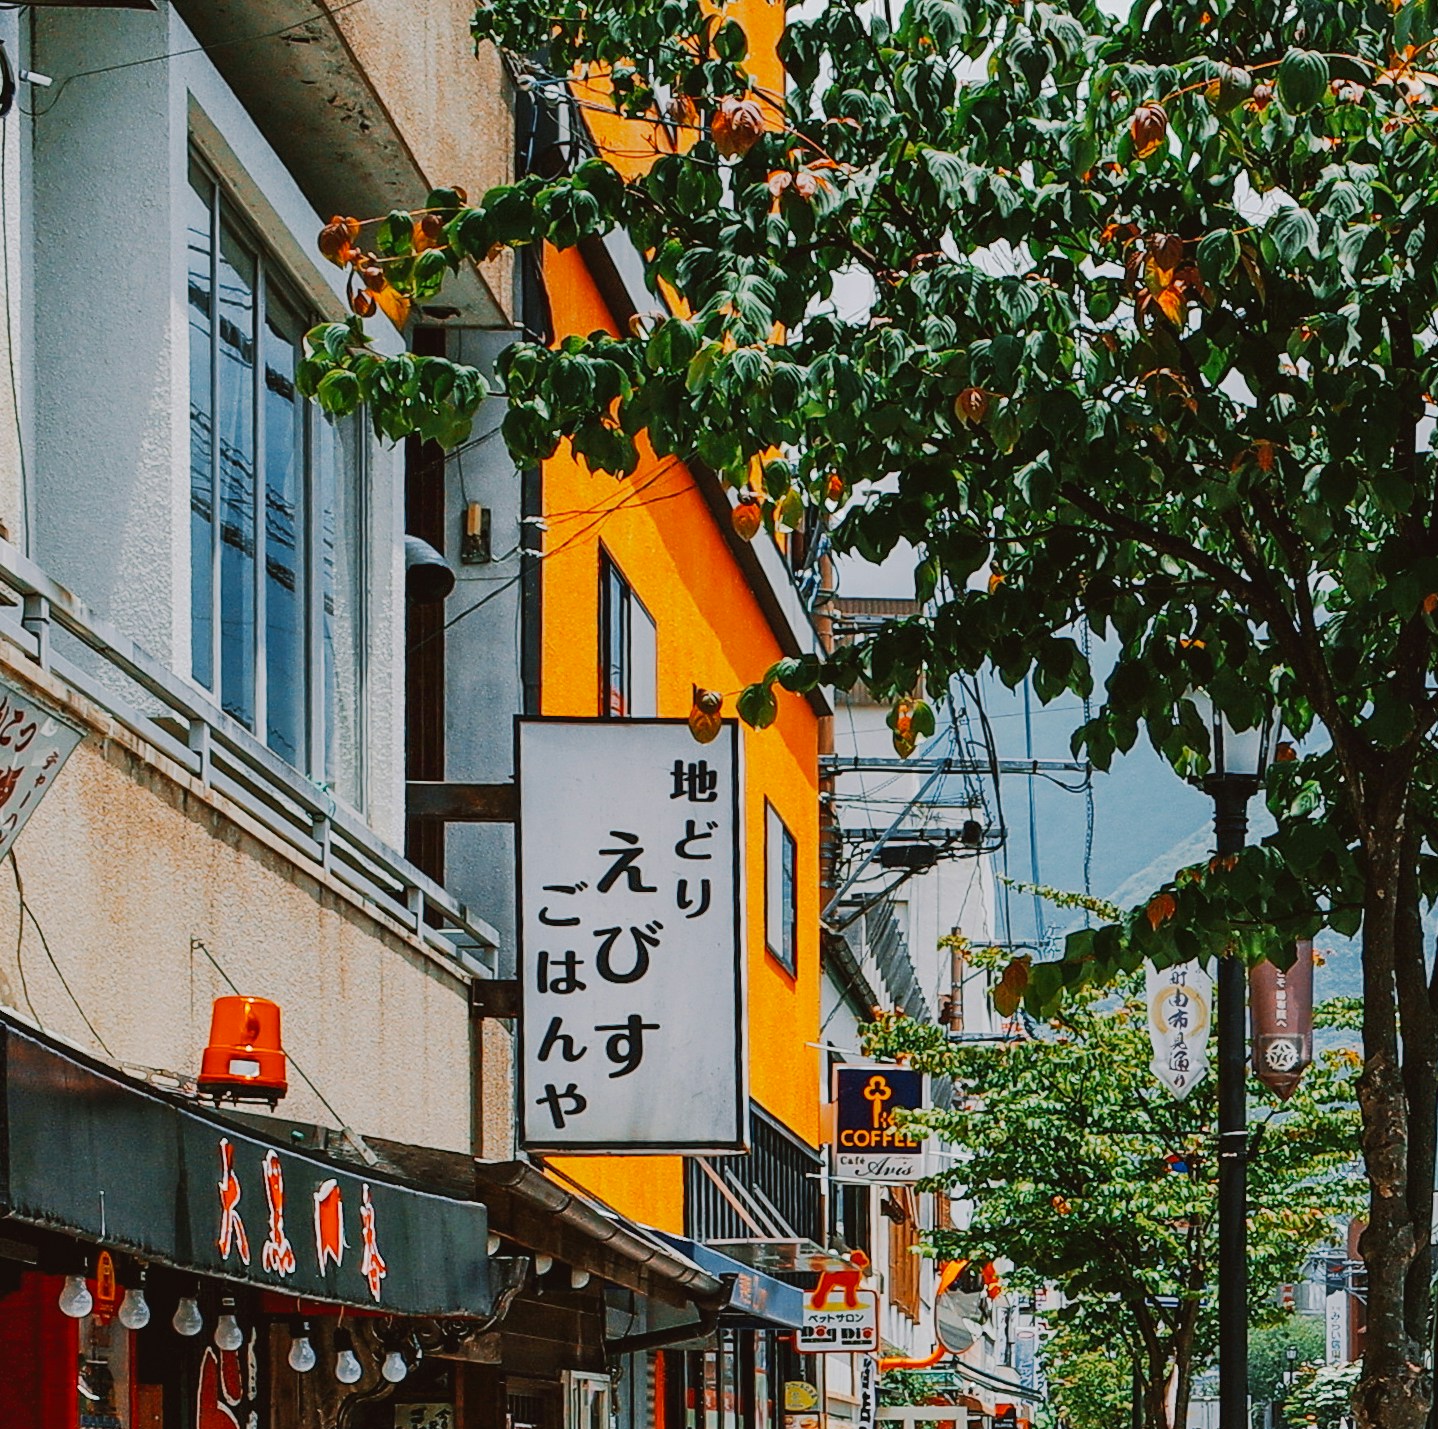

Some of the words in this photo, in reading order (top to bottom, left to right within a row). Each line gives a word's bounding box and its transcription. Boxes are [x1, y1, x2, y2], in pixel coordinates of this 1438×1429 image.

[670, 760, 719, 919] 地どり
[536, 881, 588, 1129] ごはんや
[593, 830, 664, 1079] えびす
[808, 1313, 864, 1323] ペットサロン
